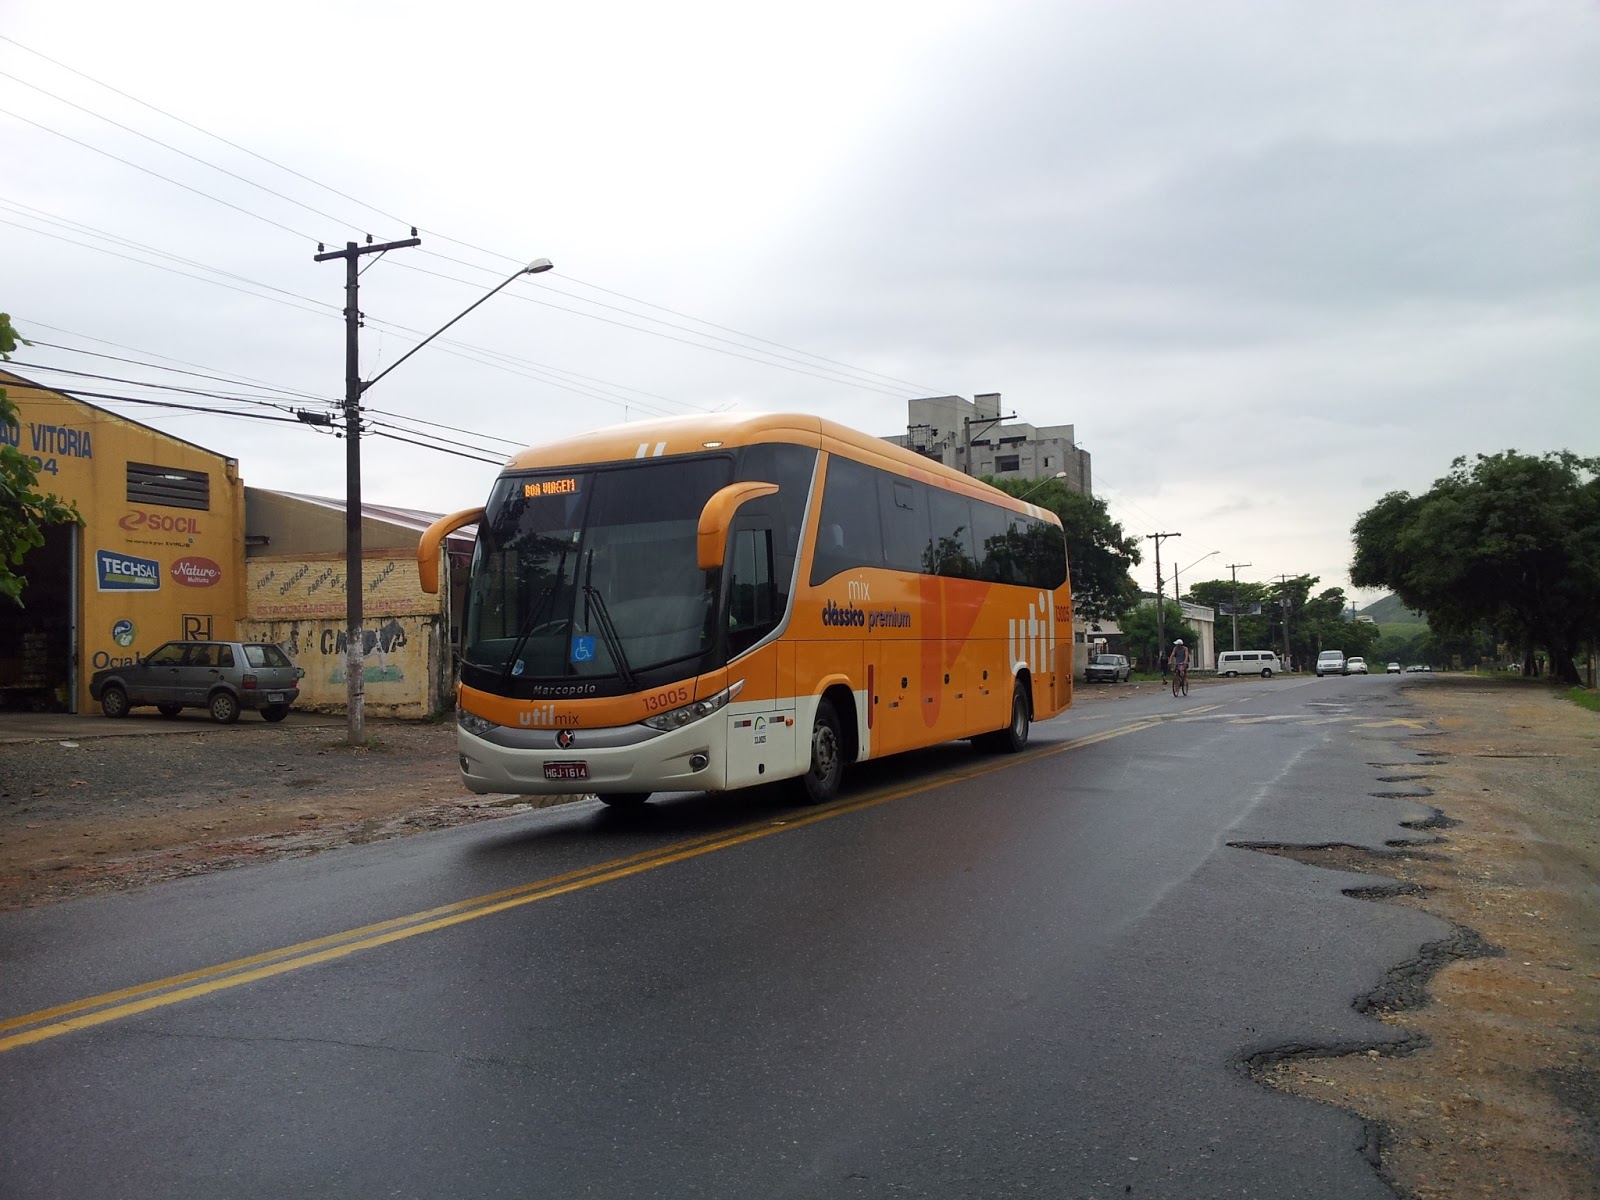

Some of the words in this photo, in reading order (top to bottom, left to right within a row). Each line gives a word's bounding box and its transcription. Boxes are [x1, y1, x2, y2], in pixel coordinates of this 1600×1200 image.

[30, 422, 92, 459] VITÓRIA
[525, 483, 541, 497] BOA
[542, 478, 576, 494] VIAGEM
[147, 514, 202, 535] SOCIL
[102, 557, 158, 579] TECHSAL
[174, 561, 217, 577] Nature
[848, 574, 870, 601] mix
[821, 599, 865, 627] clássico
[868, 607, 911, 632] premium
[1008, 589, 1055, 675] util
[532, 684, 597, 696] Marcopolo
[642, 687, 689, 712] 13005
